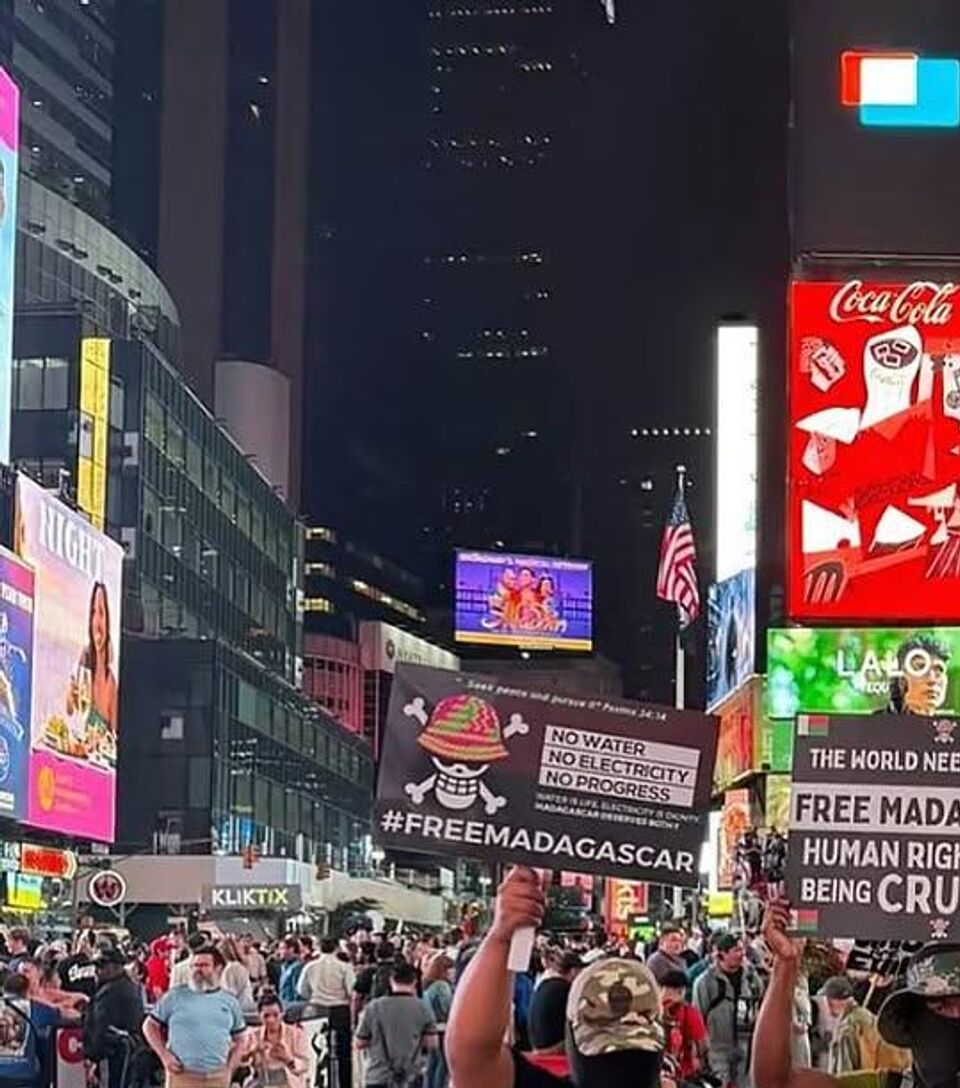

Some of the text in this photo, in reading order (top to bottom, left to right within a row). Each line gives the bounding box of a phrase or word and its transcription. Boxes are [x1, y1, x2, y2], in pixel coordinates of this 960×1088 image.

[551, 729, 646, 757] NO WATER
[549, 750, 690, 783] NO ELECTRICITY
[810, 748, 846, 769] THE
[851, 750, 919, 771] WORLD
[545, 771, 671, 802] NO PROGRESS
[795, 793, 871, 824] FREE
[381, 809, 695, 874] #FREEMADAGASCAR
[802, 838, 900, 869] HUMAN
[801, 879, 871, 903] BEING
